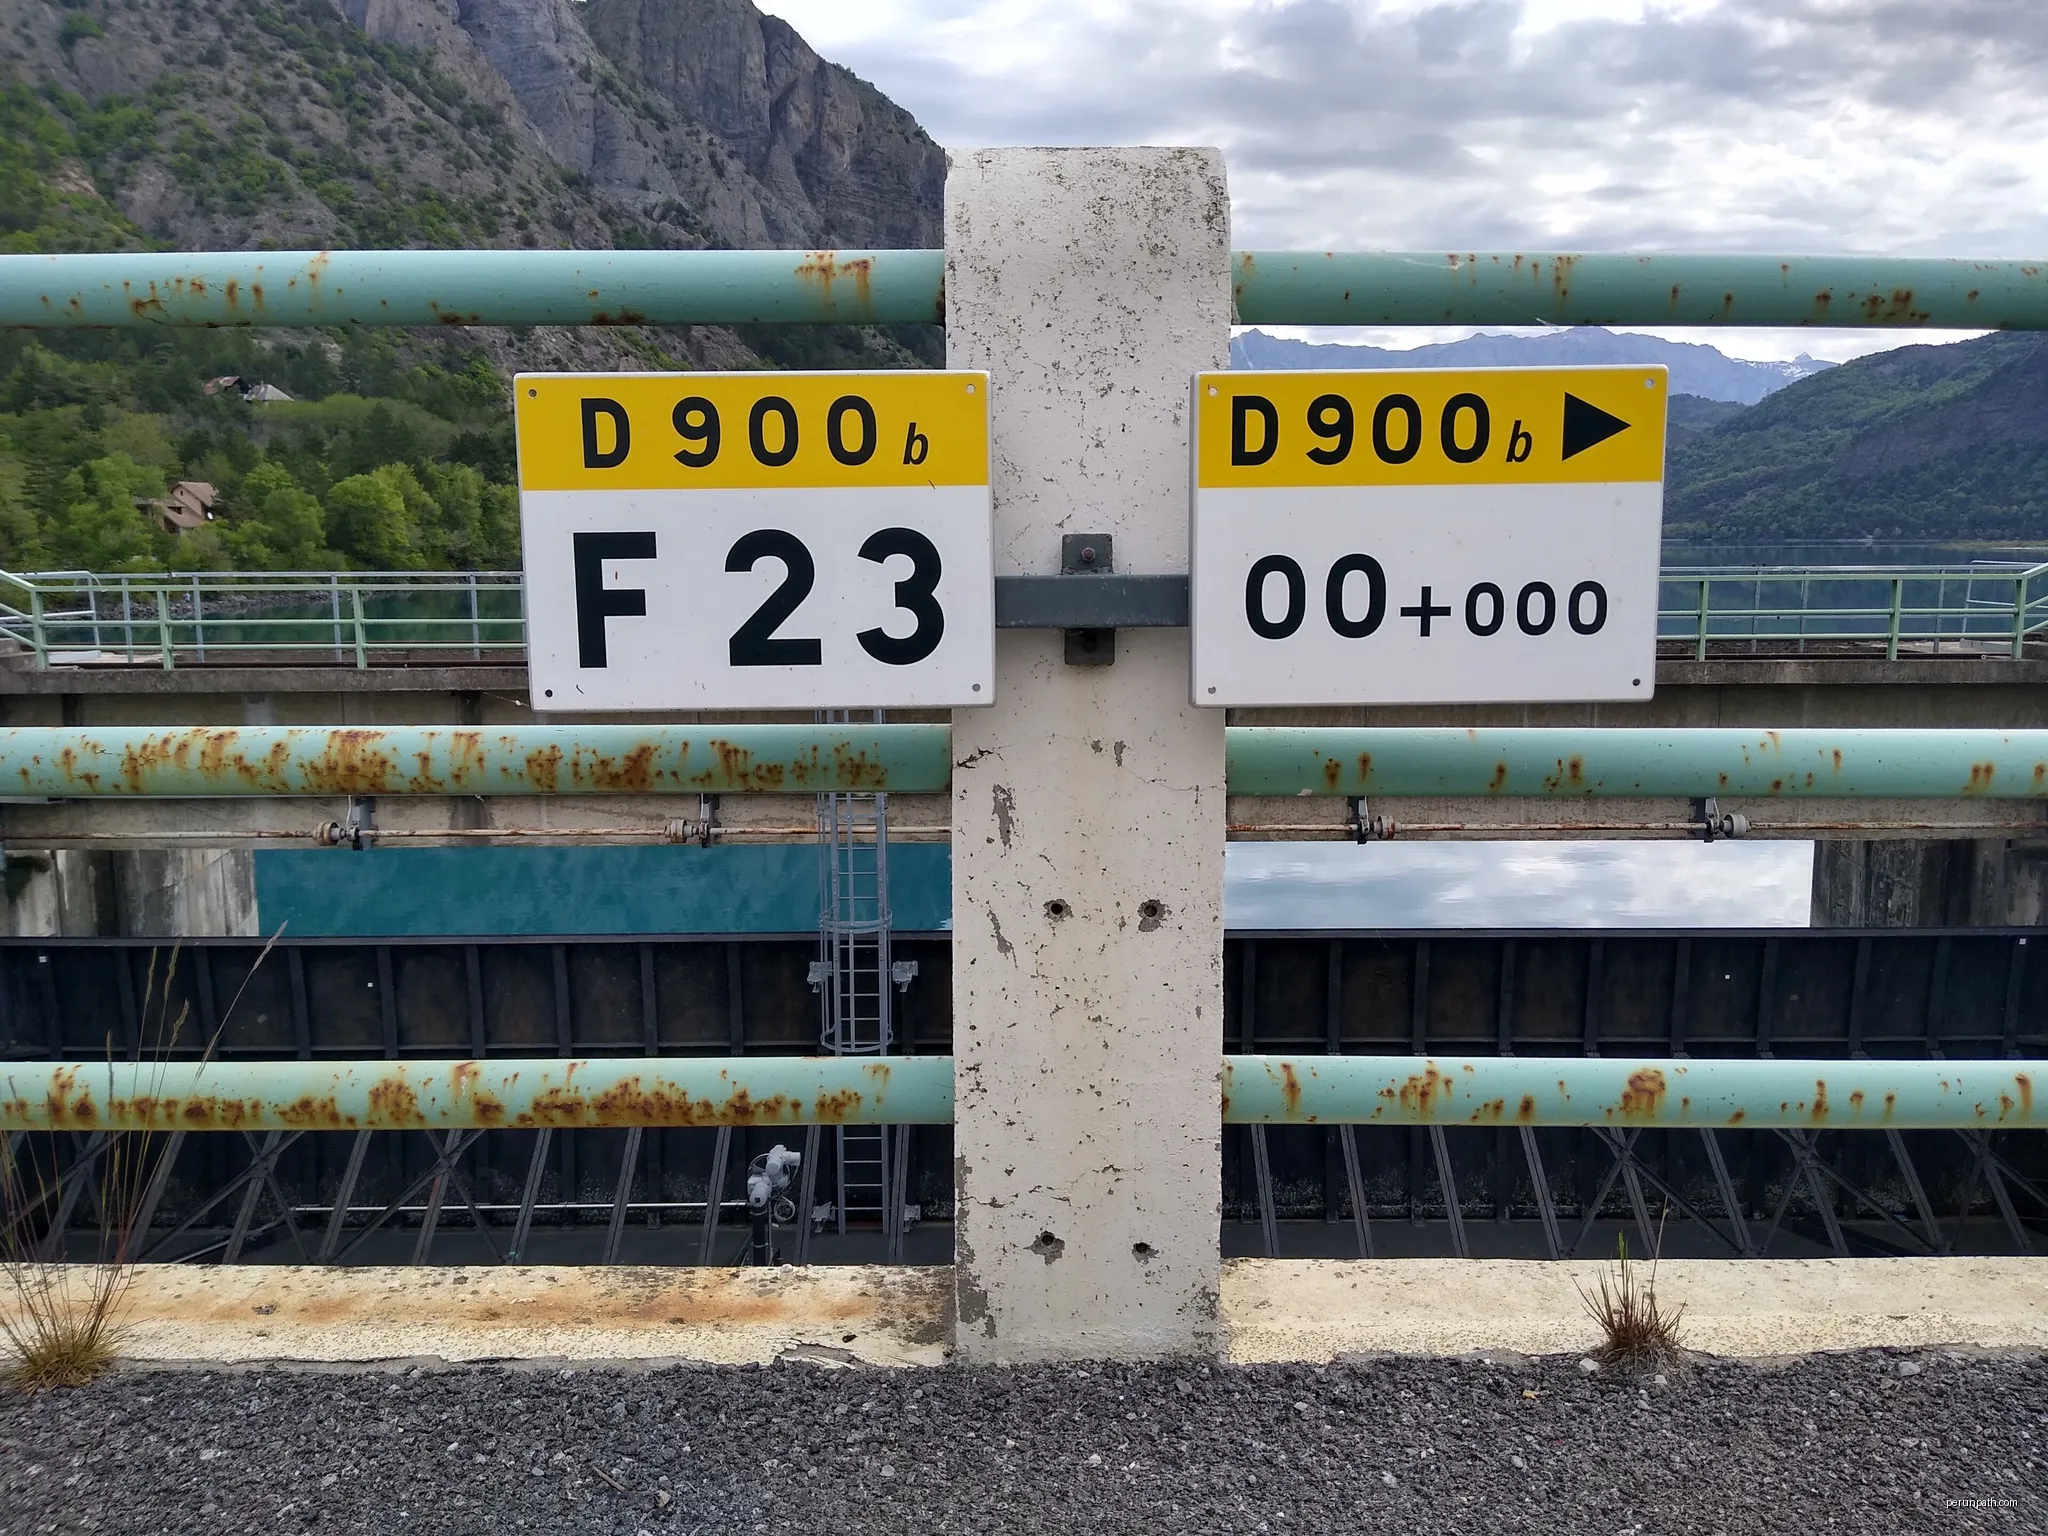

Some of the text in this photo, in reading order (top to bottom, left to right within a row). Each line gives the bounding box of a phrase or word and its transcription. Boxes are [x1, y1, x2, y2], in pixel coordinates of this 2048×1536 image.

[580, 397, 631, 469] D
[1231, 395, 1279, 467] D
[572, 527, 945, 669] F 23
[1245, 553, 1609, 640] 00+000
